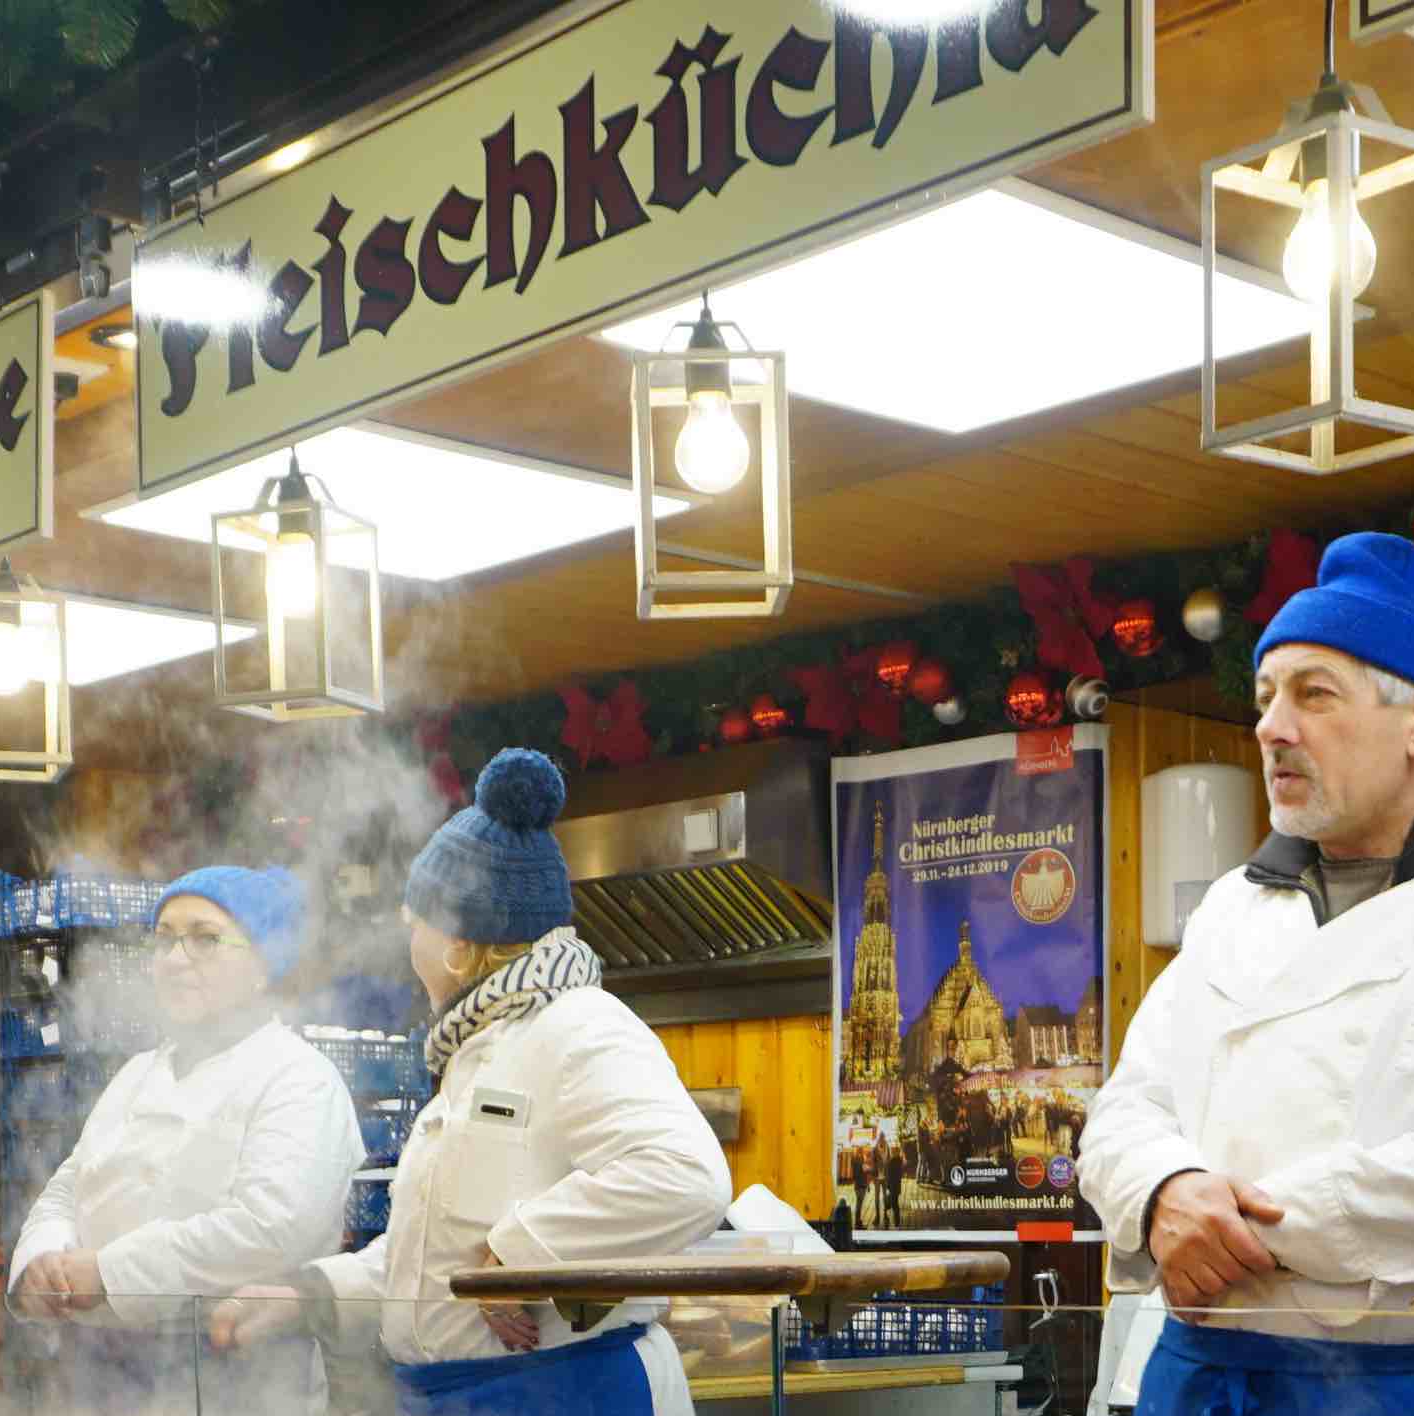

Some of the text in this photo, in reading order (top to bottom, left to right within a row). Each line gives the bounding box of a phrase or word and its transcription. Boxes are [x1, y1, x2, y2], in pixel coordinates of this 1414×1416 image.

[912, 813, 996, 839] Nürnberger
[898, 822, 1075, 863] Christkindlesmarkt
[910, 1194, 1075, 1210] www.christkindlesmarkt.de
